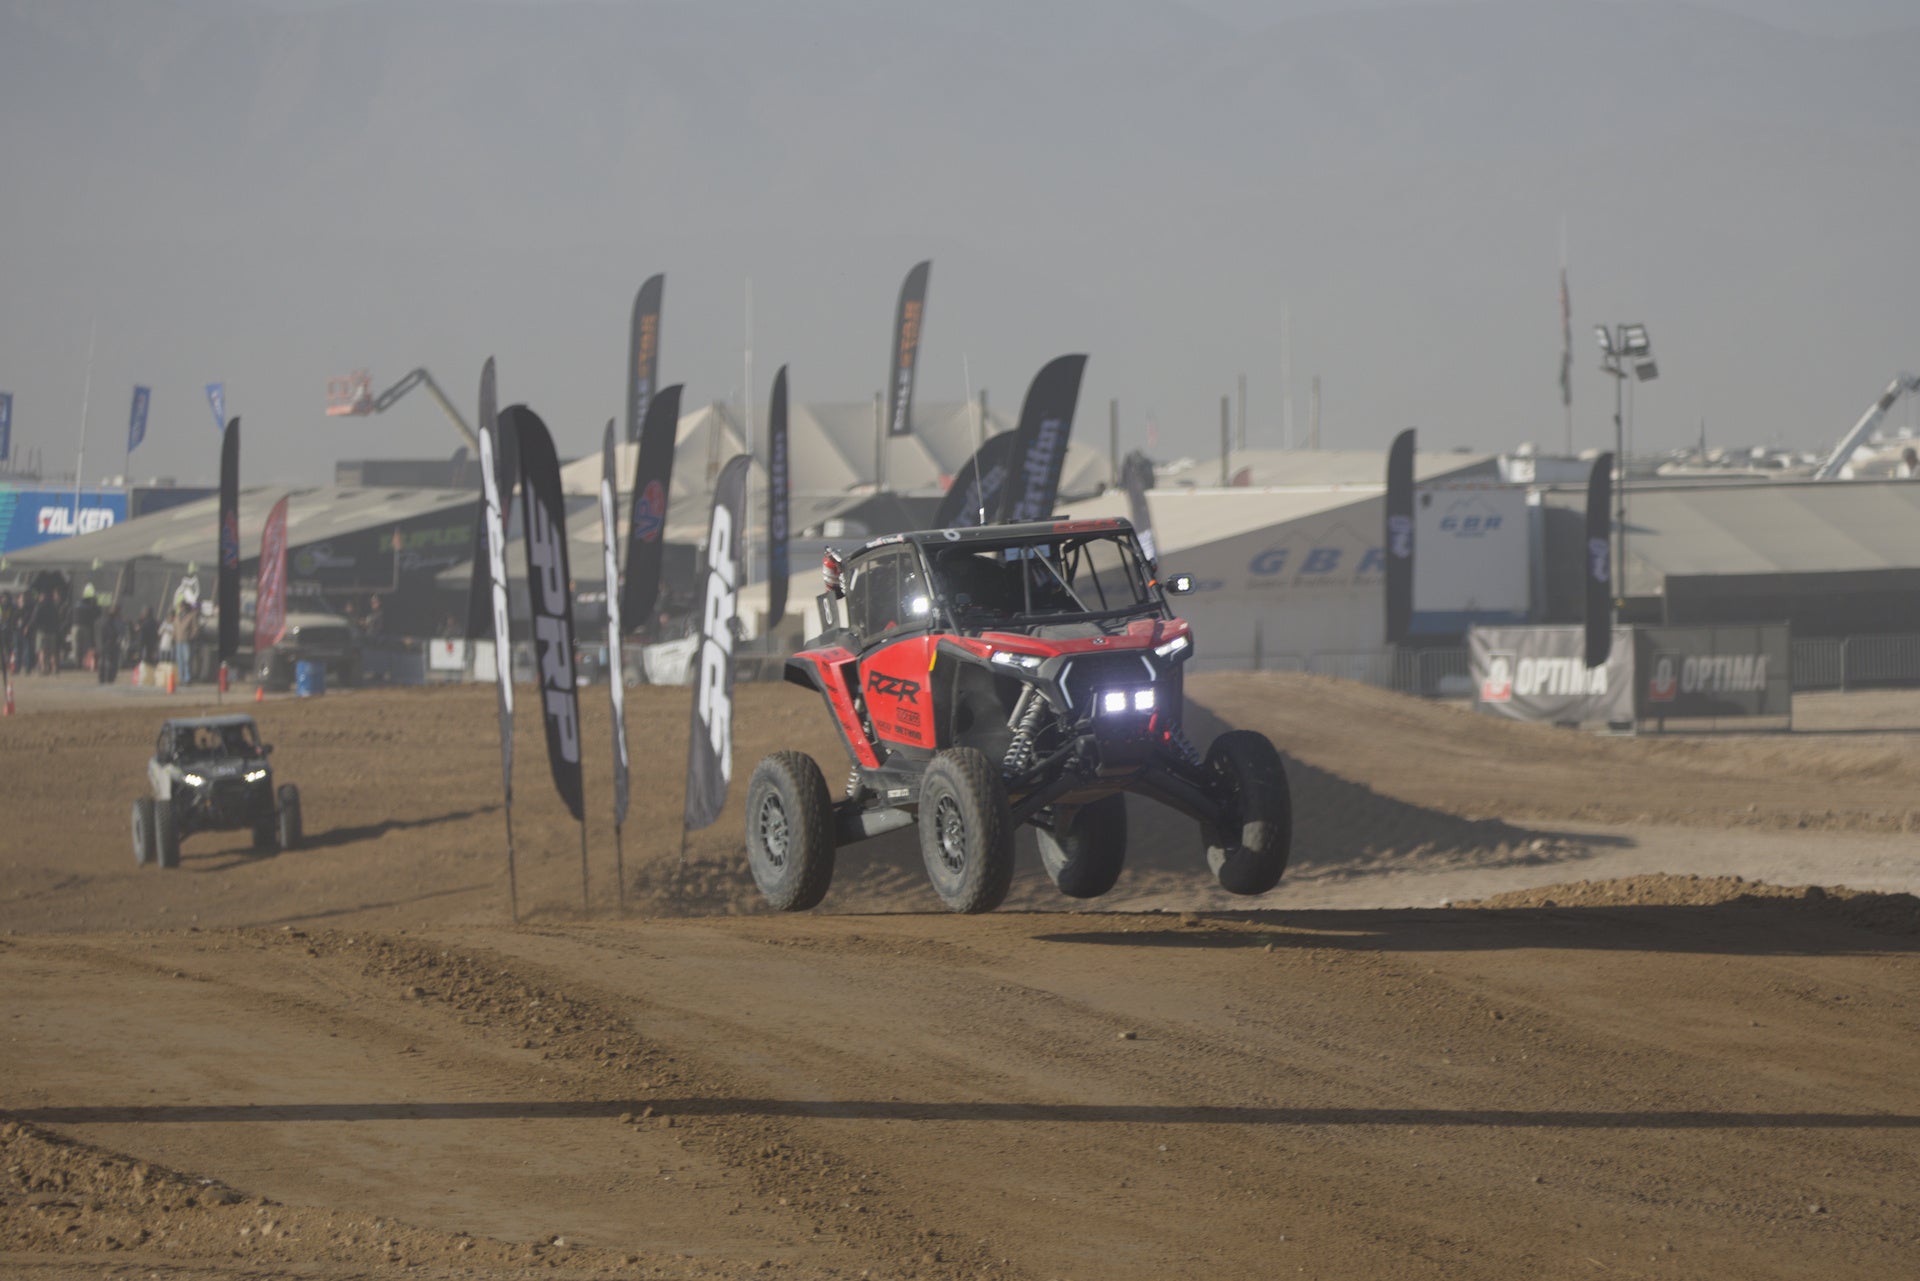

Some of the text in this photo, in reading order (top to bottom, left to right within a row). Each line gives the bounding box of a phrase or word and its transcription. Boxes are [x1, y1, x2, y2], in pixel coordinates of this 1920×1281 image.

[37, 506, 115, 535] FALKEN
[867, 670, 921, 704] RZR
[1515, 656, 1609, 696] OPTIMA
[1680, 654, 1767, 693] OPTIMA
